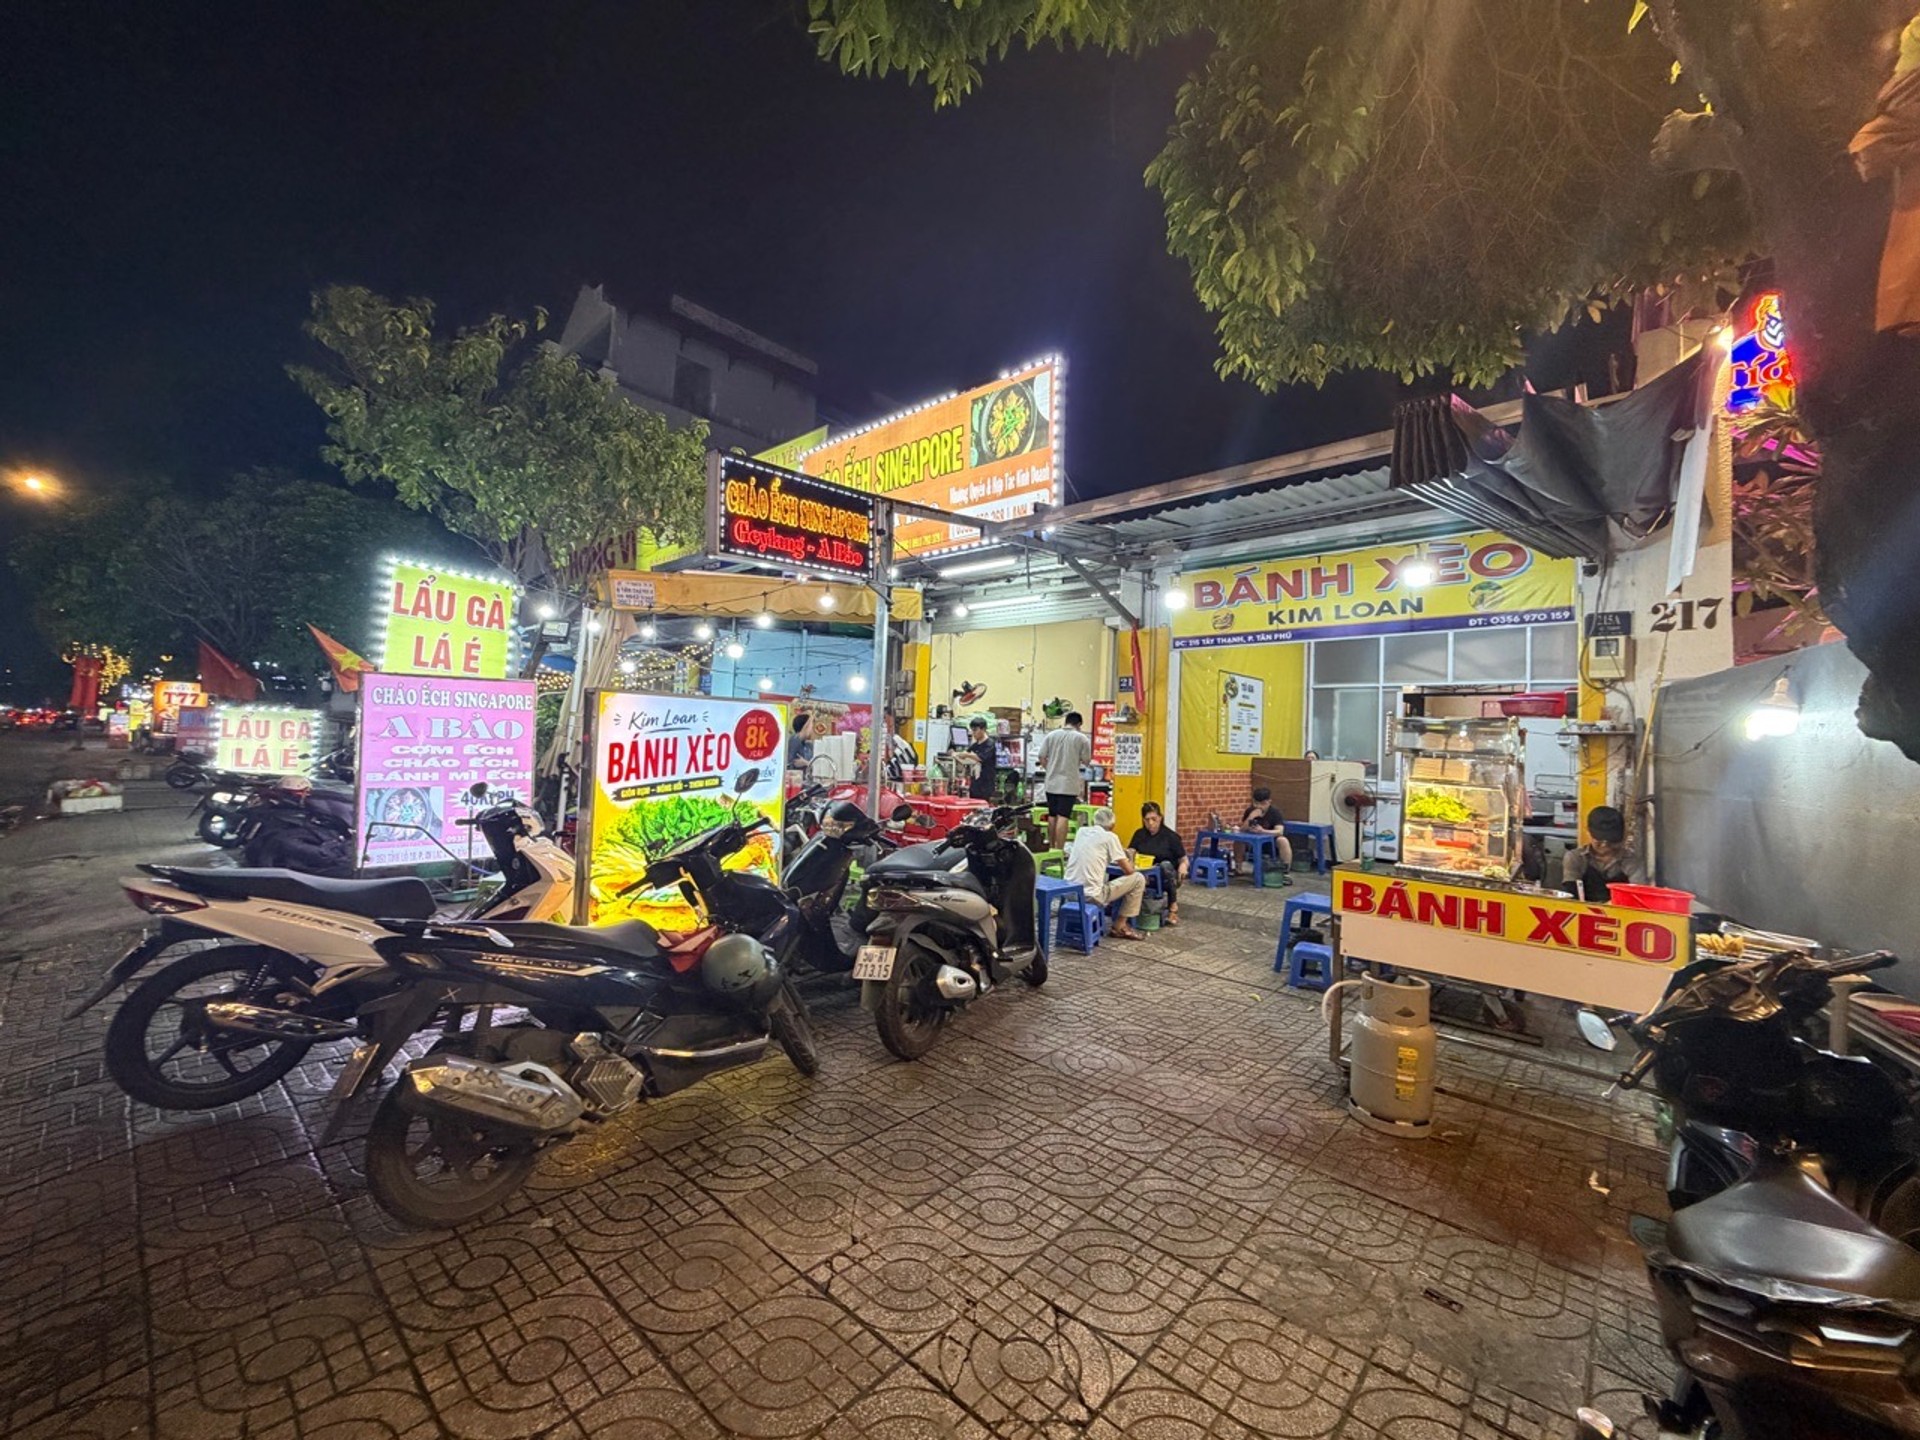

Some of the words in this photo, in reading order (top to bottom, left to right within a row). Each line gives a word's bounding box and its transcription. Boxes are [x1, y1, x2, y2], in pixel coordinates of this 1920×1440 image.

[875, 425, 964, 495] SINGAPORE
[800, 499, 869, 544] SINGAPORE
[734, 519, 806, 559] Geylang
[1193, 564, 1351, 609] BÁNH
[1376, 541, 1530, 591] XÈO
[392, 574, 457, 624] LẨU
[466, 592, 506, 631] GÀ
[1268, 602, 1323, 626] KIM
[1335, 596, 1424, 621] LOAN
[1490, 615, 1520, 625] 0356
[1523, 613, 1547, 622] 970
[1550, 610, 1571, 620] 159
[1651, 597, 1724, 633] 217
[413, 633, 451, 671] LÁ
[462, 636, 482, 674] É
[164, 692, 200, 704] T77
[372, 681, 417, 706] CHẢO
[420, 681, 451, 707] ẾCH
[454, 690, 534, 711] SINGAPORE
[221, 712, 270, 739] LẨU
[280, 716, 312, 740] GÀ
[377, 714, 417, 739] A
[427, 712, 525, 740] BẢO
[628, 711, 660, 730] Kim
[662, 709, 698, 728] Loan
[463, 742, 514, 755] ẾCH
[745, 725, 769, 749] 8k
[233, 744, 271, 769] LÁ
[282, 744, 299, 768] É
[382, 756, 461, 768] CHÁO
[469, 755, 519, 767] ẾCH
[607, 733, 678, 784] BÁNH
[686, 727, 732, 775] XÈO
[366, 768, 439, 781] BÁNH
[486, 768, 532, 780] ẾCH
[1342, 880, 1505, 936] BÁNH
[1528, 906, 1676, 962] XÈO
